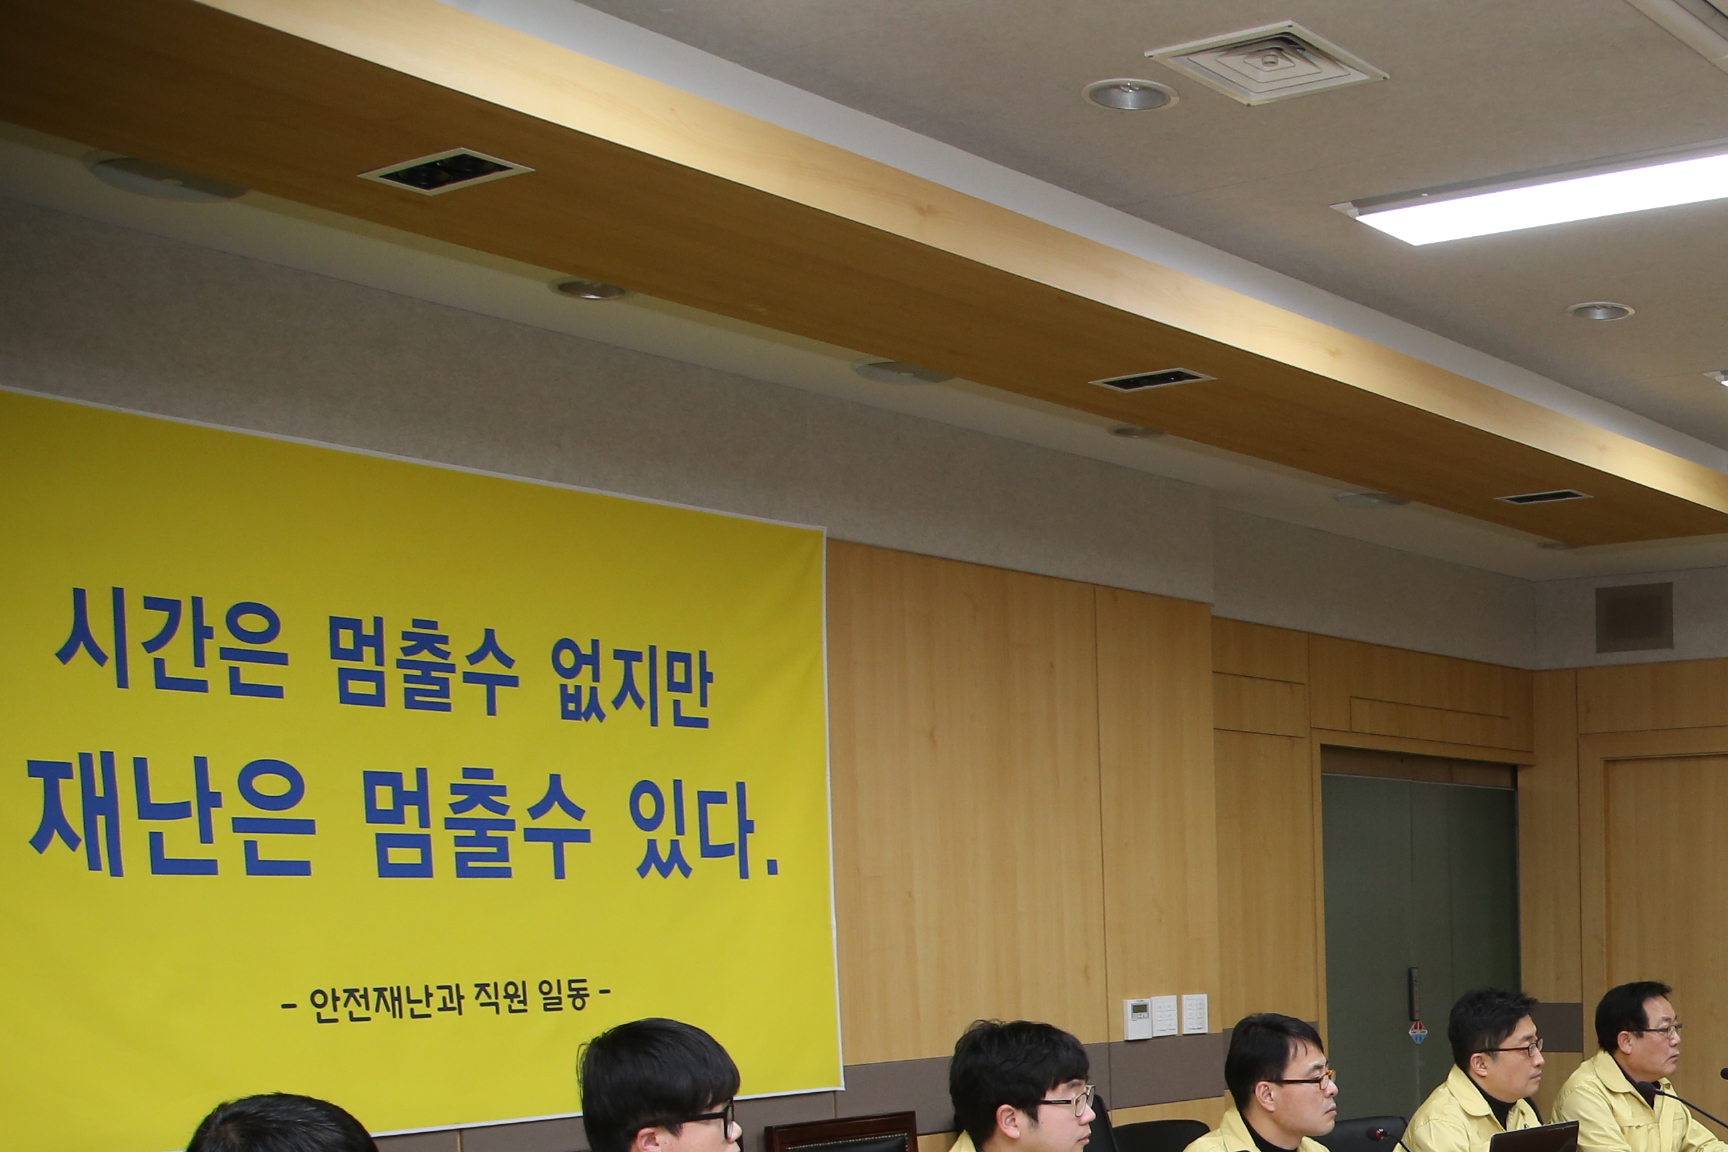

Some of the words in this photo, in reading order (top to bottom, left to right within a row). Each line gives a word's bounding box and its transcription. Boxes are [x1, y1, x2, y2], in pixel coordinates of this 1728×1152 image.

[57, 587, 289, 699] 시간은
[329, 616, 519, 716] 멈출수
[552, 638, 713, 729] 없지만
[27, 750, 316, 877] 재난은
[363, 767, 591, 880] 멈출수
[629, 779, 779, 879] 있다.
[309, 982, 465, 1024] 안전재난과
[473, 980, 528, 1015] 직원
[538, 978, 590, 1012] 일동
